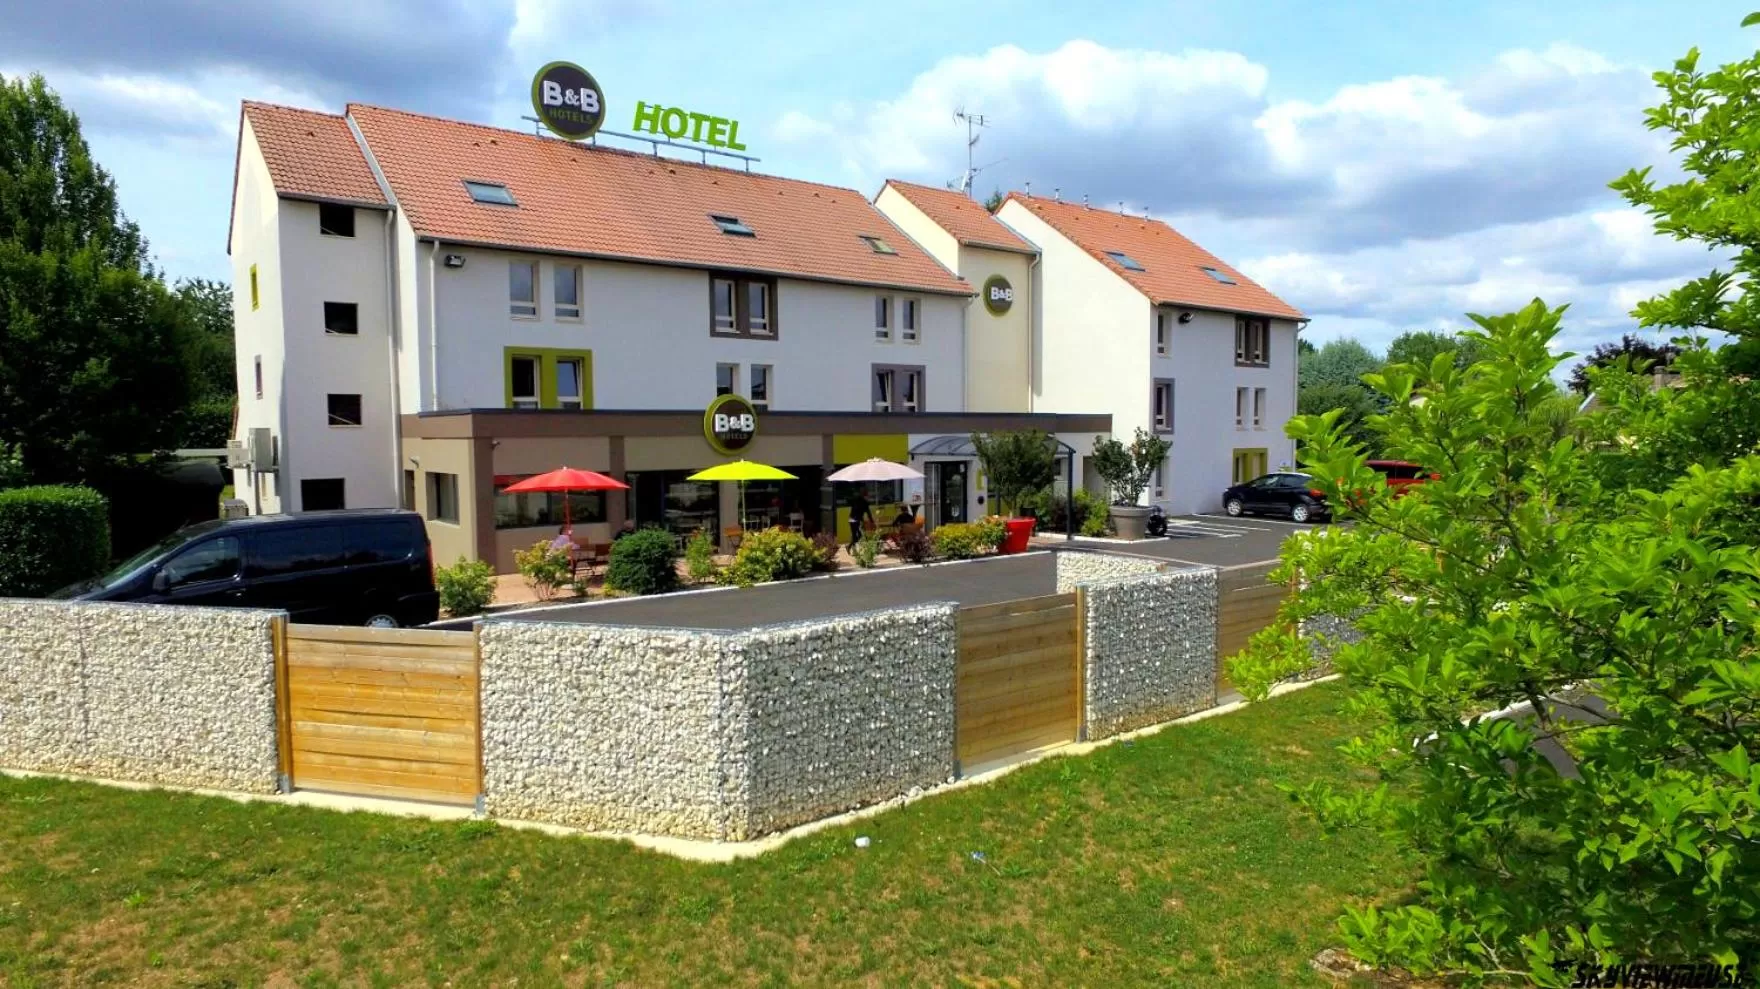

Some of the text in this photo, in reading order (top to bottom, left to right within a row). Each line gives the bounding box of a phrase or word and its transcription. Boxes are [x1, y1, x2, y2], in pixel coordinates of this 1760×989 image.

[543, 80, 600, 113] B&B
[549, 107, 593, 125] HOTELS
[632, 101, 746, 151] HOTEL
[991, 286, 1012, 301] B&B
[715, 413, 754, 433] B&B
